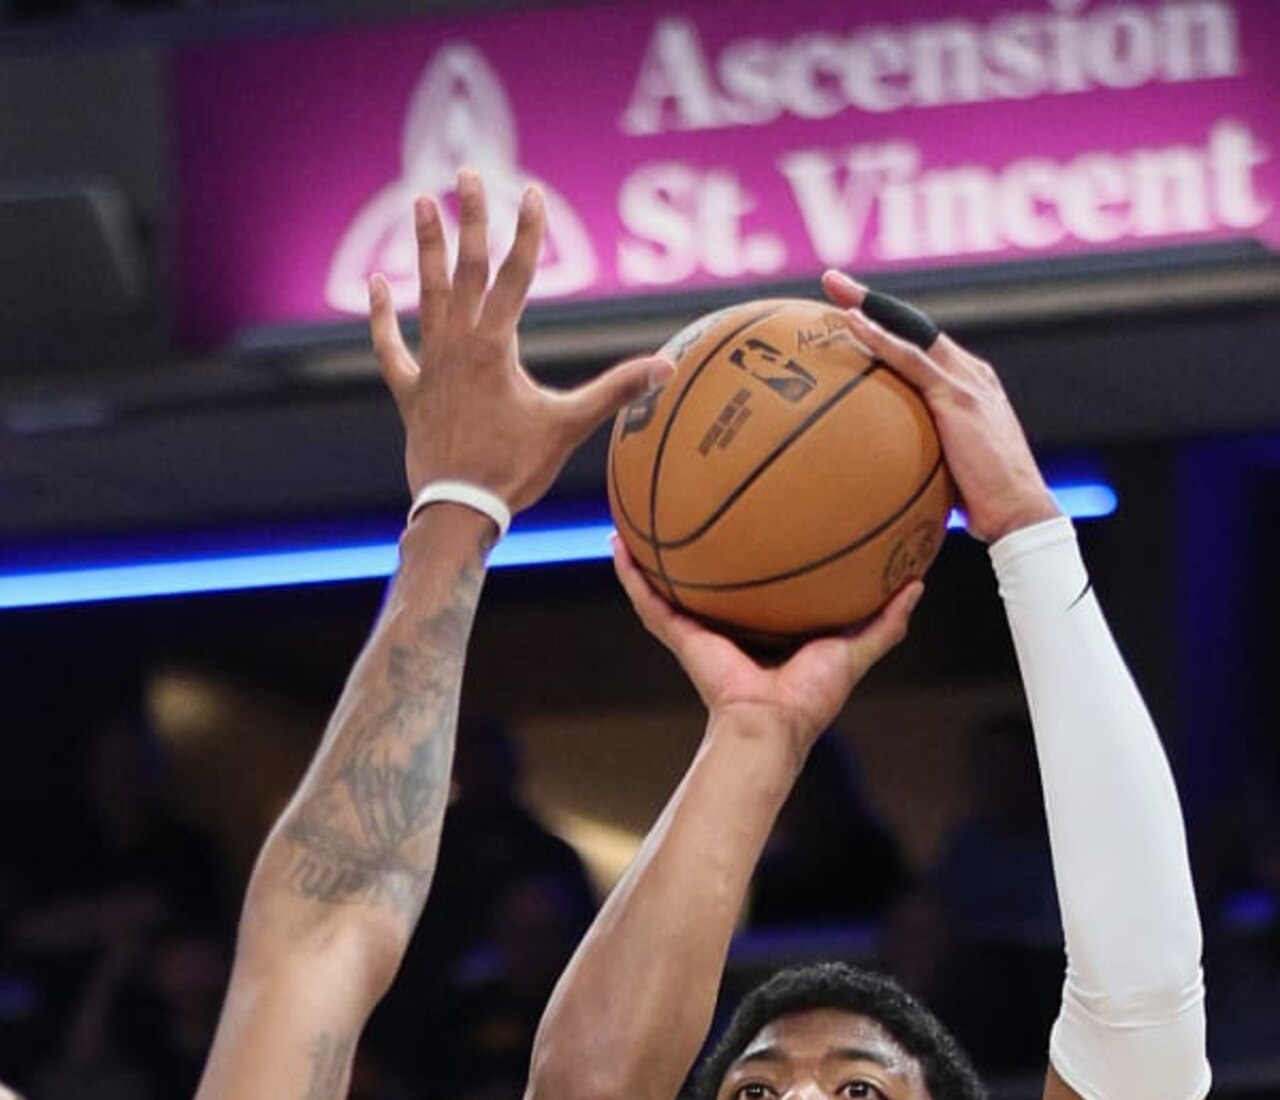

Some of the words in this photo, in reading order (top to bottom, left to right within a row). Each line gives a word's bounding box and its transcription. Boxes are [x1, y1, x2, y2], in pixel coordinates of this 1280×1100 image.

[619, 0, 1244, 134] Ascension
[614, 160, 787, 288] St.
[780, 120, 1273, 264] Vincent
